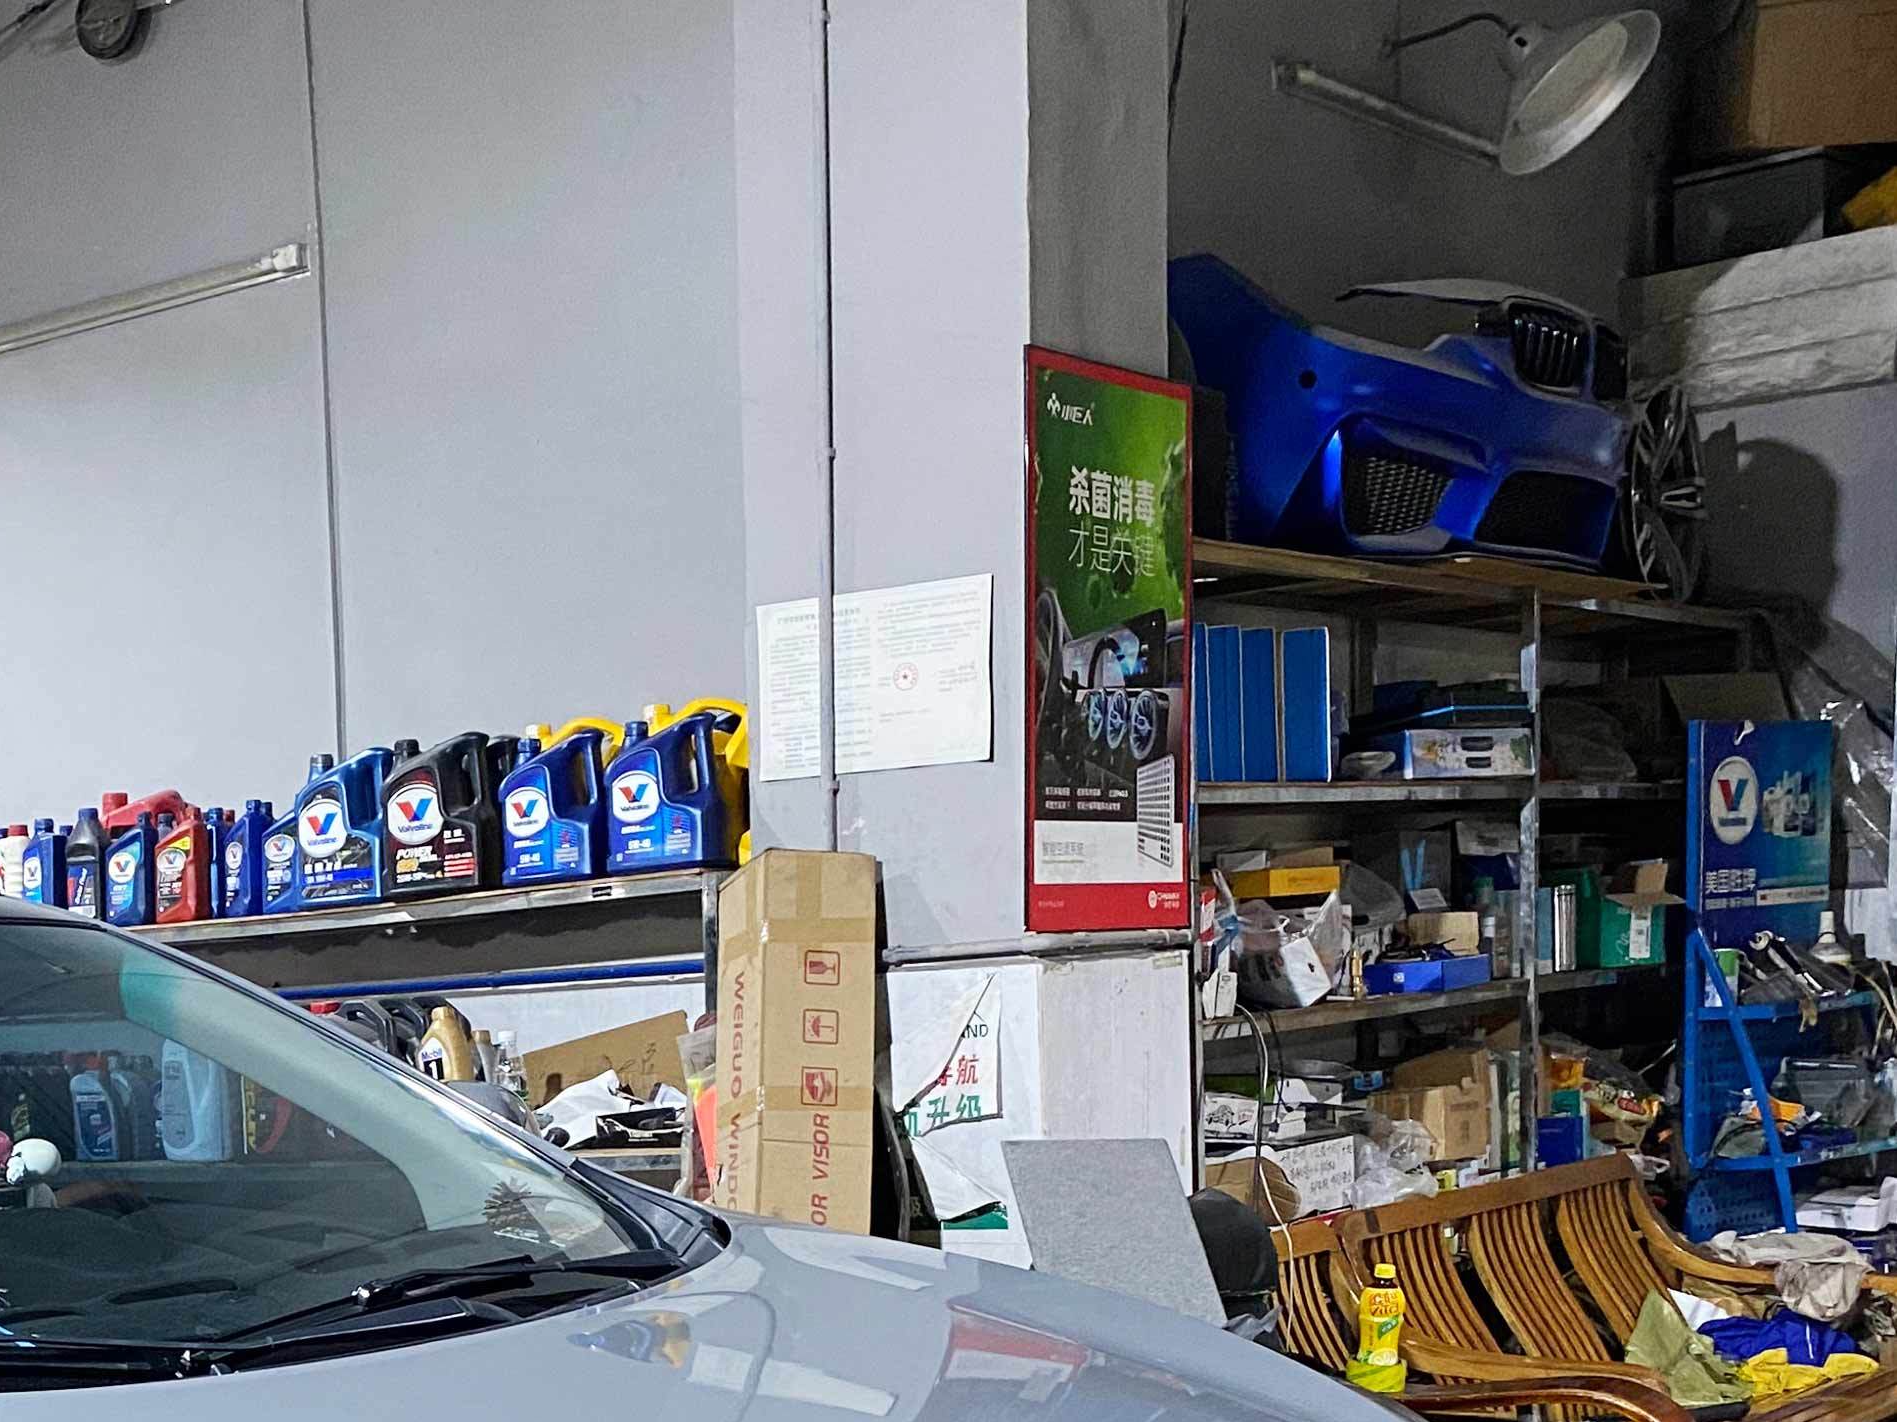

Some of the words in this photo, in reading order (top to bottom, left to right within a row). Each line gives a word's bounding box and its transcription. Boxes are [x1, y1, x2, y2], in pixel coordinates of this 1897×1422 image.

[1068, 464, 1156, 527] 杀菌消毒
[730, 971, 745, 1099] WEIGUO
[812, 1113, 830, 1181] VISOR
[811, 1193, 829, 1226] OR
